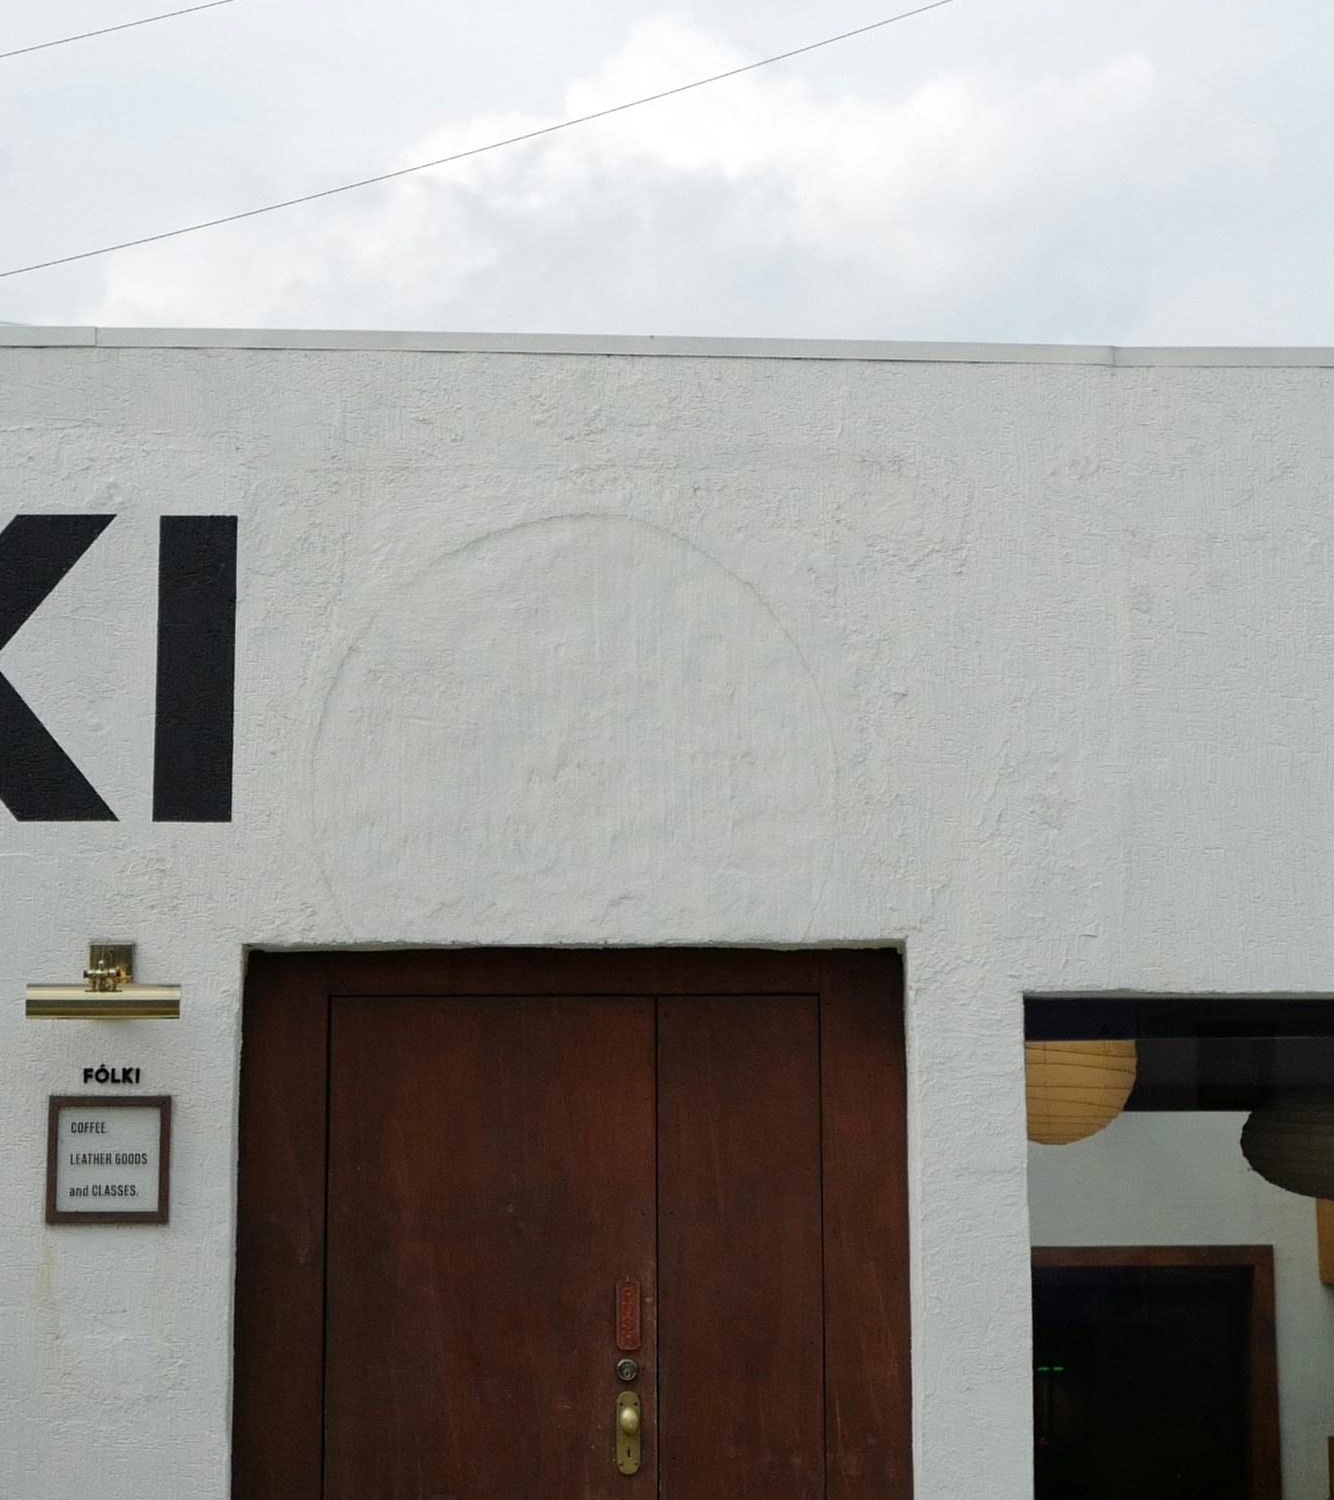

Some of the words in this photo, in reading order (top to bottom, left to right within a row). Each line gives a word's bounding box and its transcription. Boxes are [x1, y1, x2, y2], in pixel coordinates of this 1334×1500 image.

[83, 1064, 140, 1084] FÓLKI
[70, 1121, 106, 1134] COFFEE
[70, 1153, 112, 1166] LEATHER
[114, 1153, 148, 1166] GOODS
[69, 1185, 89, 1197] and
[91, 1184, 139, 1197] CLASSES.
